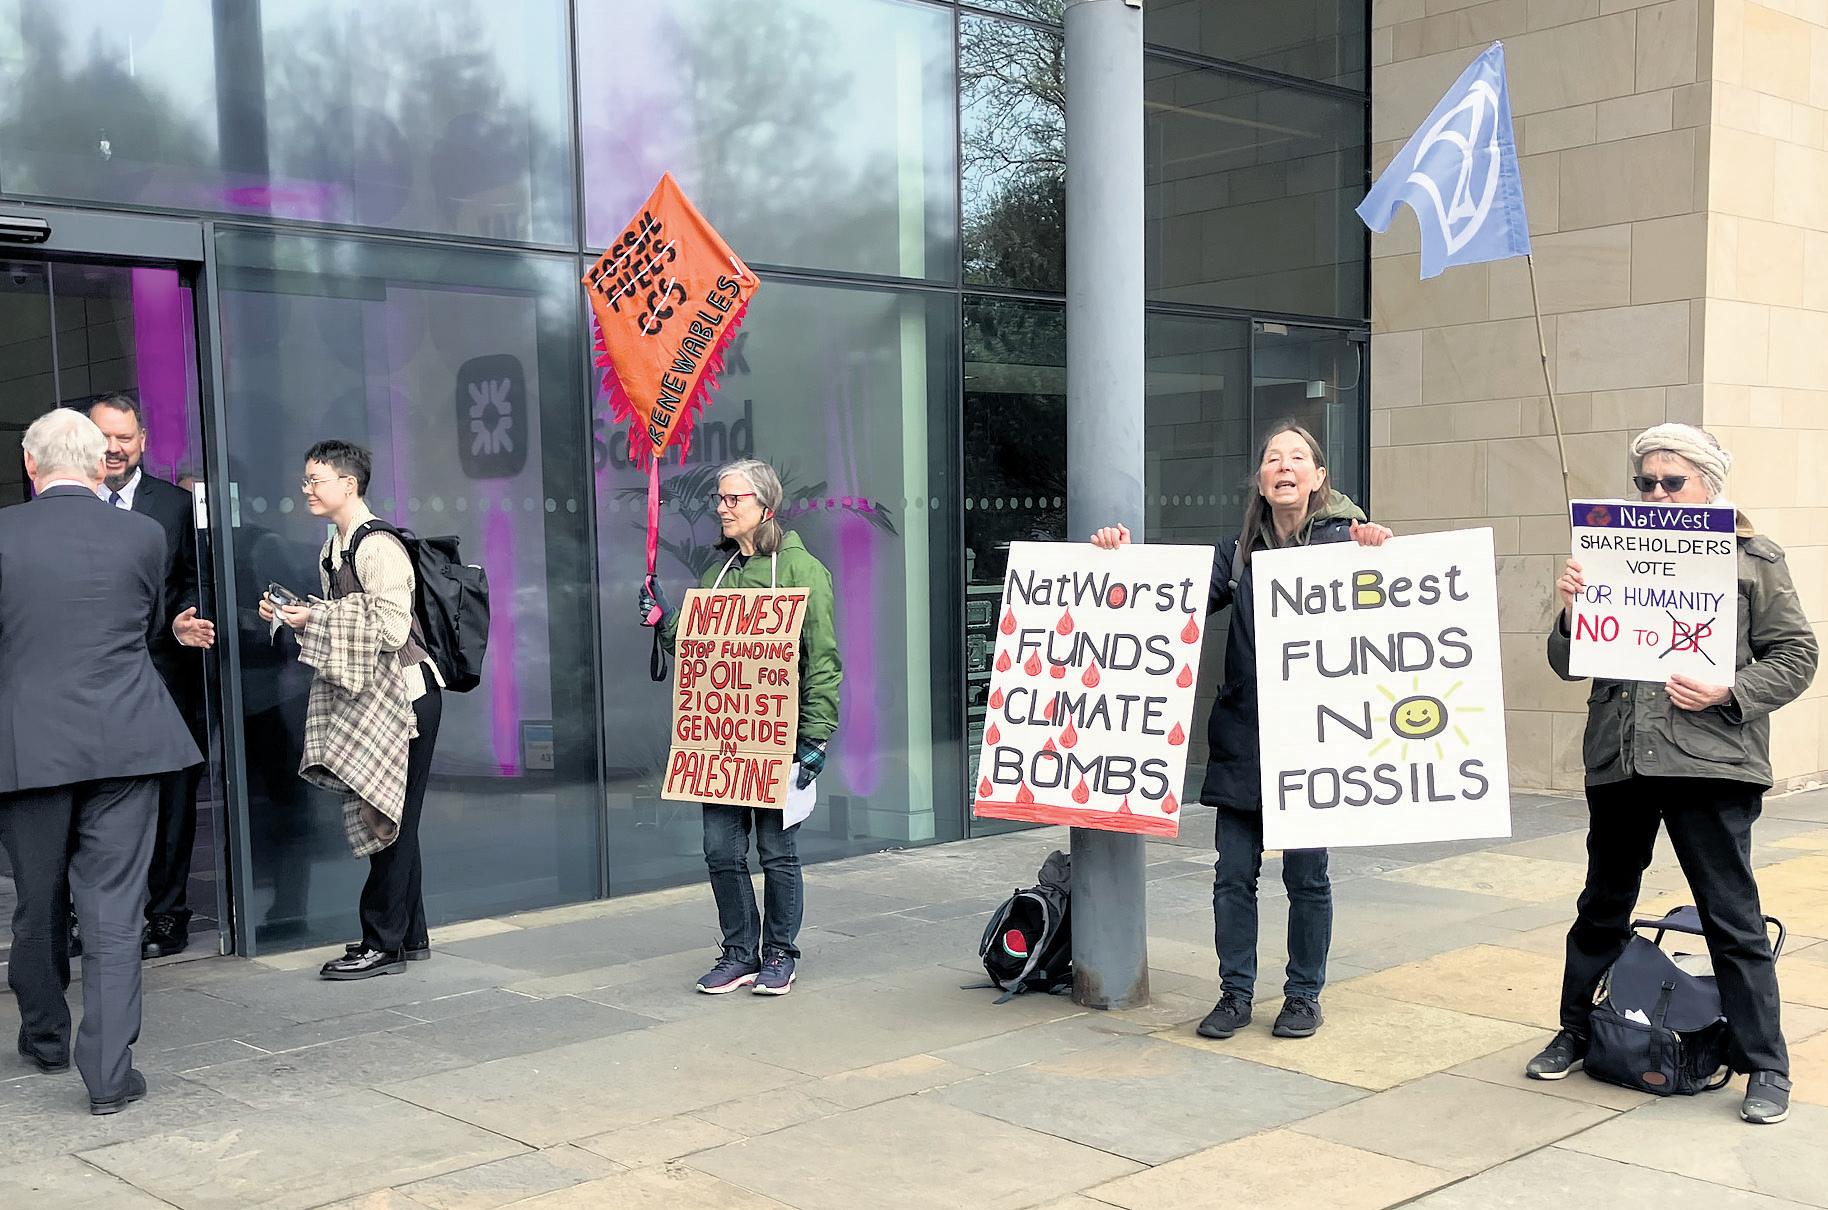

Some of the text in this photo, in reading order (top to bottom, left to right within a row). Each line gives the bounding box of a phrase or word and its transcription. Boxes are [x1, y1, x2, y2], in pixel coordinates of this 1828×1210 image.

[589, 211, 663, 294] FOSSIL
[605, 238, 677, 313] FUELS
[637, 276, 687, 335] CCS
[648, 274, 741, 446] RENEWABLES
[1620, 507, 1710, 530] NatWest
[1580, 535, 1732, 555] SHAREHOLDERS
[1006, 569, 1197, 614] NatWorst
[1271, 565, 1469, 617] NatBest
[1626, 560, 1676, 577] VOTE
[686, 594, 805, 636] NATWEST
[1624, 586, 1725, 612] HUMANITY
[680, 640, 794, 662] STOP FUNDING
[1016, 628, 1175, 675] FUNDS
[1282, 627, 1473, 681] FUNDS
[1576, 613, 1712, 653] NO TO BP
[680, 659, 790, 690] BP OIL FOR
[678, 691, 788, 717] ZIONIST
[1004, 687, 1168, 735] CLIMATE
[1317, 695, 1448, 743] NO
[677, 715, 788, 745] GENOCIDE
[719, 740, 737, 757] IN
[667, 751, 783, 804] PALESTINE
[992, 746, 1169, 800] BOMBS
[1278, 759, 1489, 811] FOSSILS
